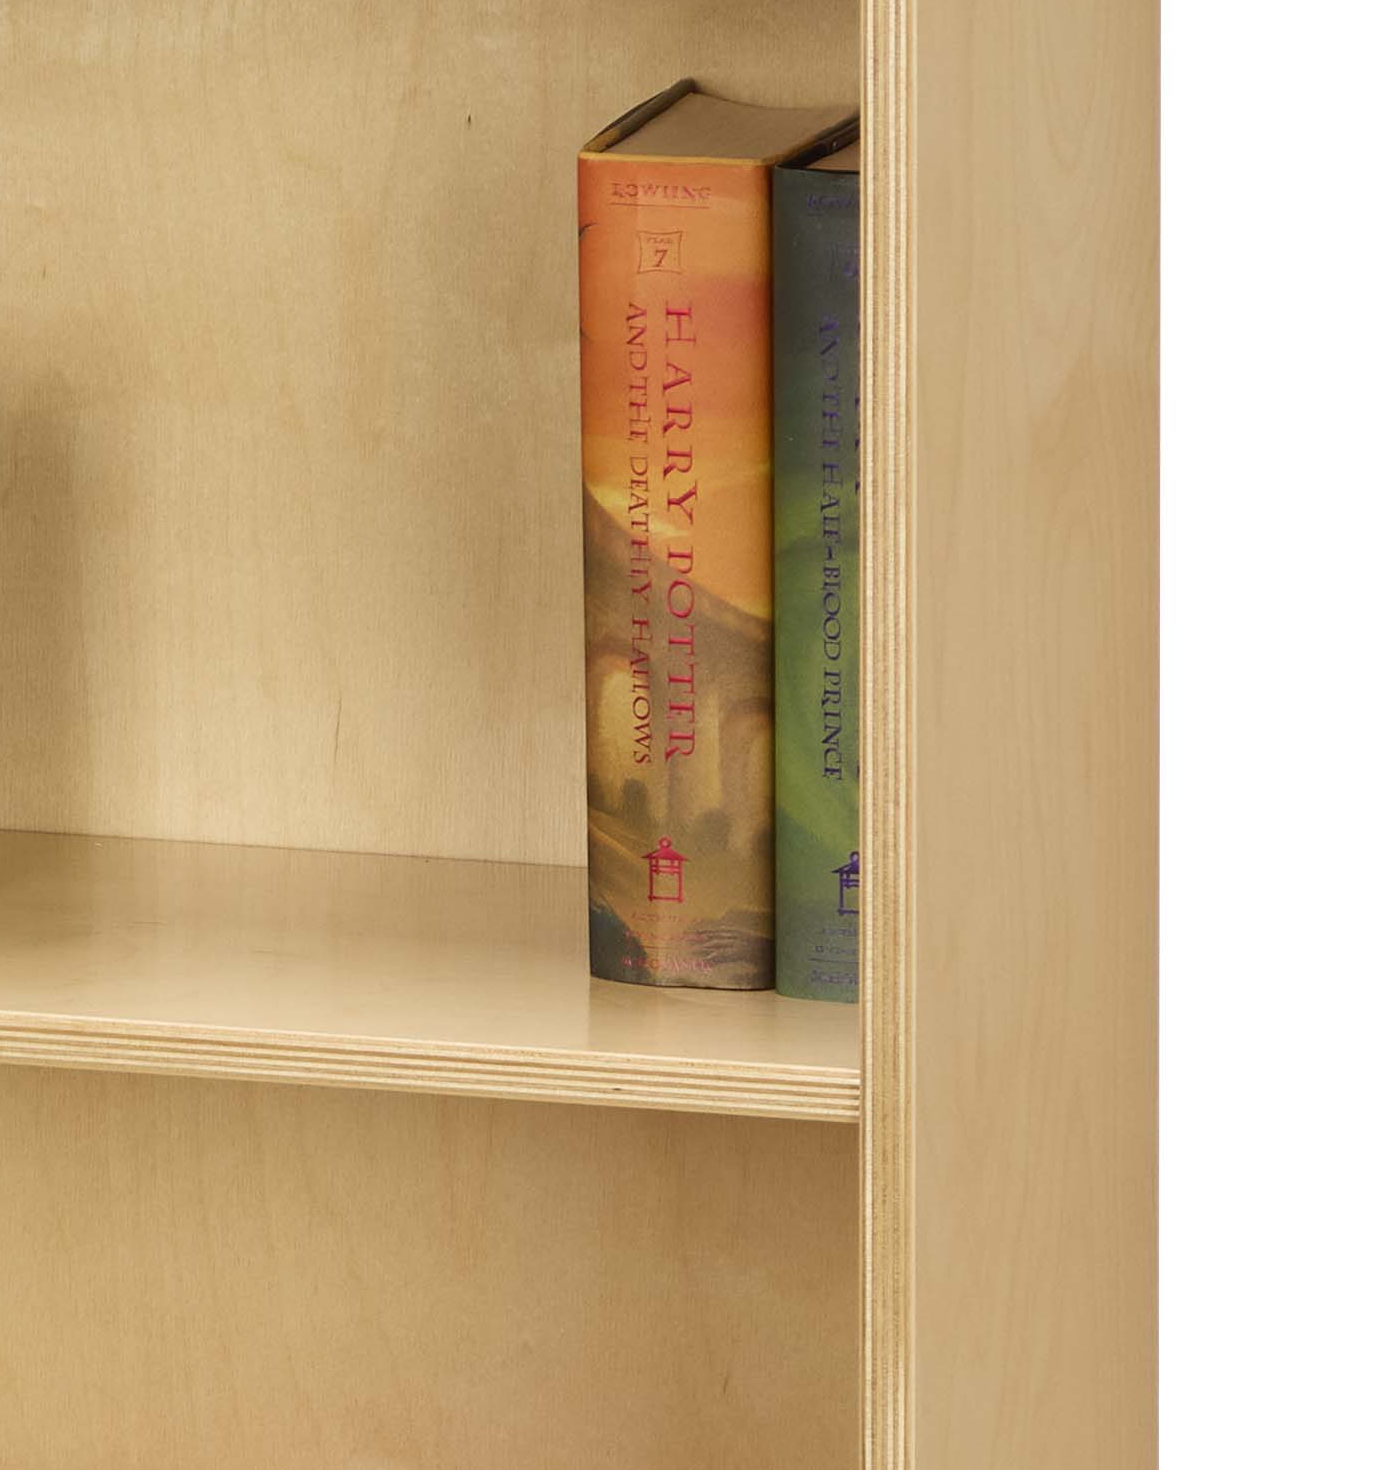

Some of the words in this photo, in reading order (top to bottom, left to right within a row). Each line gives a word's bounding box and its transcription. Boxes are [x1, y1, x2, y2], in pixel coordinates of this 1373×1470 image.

[626, 302, 650, 371] AND
[626, 376, 651, 443] THE
[662, 301, 698, 524] HARRY
[627, 454, 652, 605] DEATHLY
[628, 618, 654, 765] HALLOWS
[664, 546, 696, 762] POTTER
[821, 670, 844, 781] PRINCE
